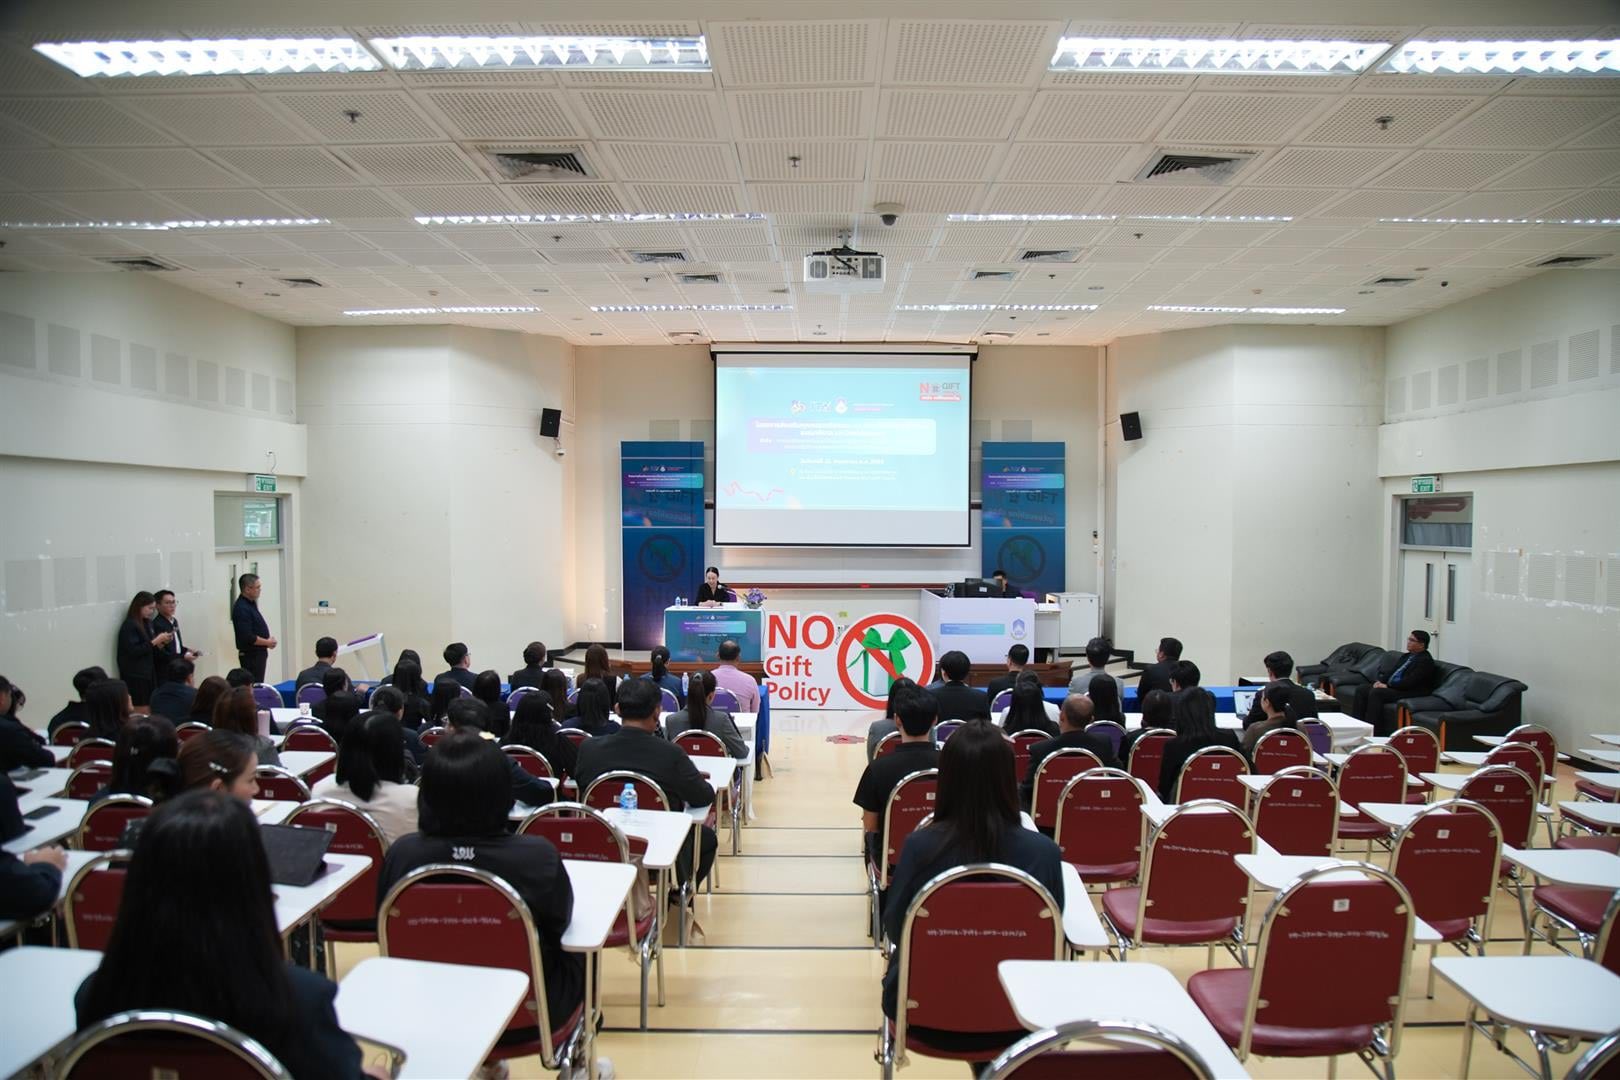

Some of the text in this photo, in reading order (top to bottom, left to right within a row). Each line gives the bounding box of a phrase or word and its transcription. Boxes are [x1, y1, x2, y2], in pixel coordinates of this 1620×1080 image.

[768, 614, 835, 650] NO
[766, 655, 812, 677] Gift
[766, 681, 831, 707] Policy
